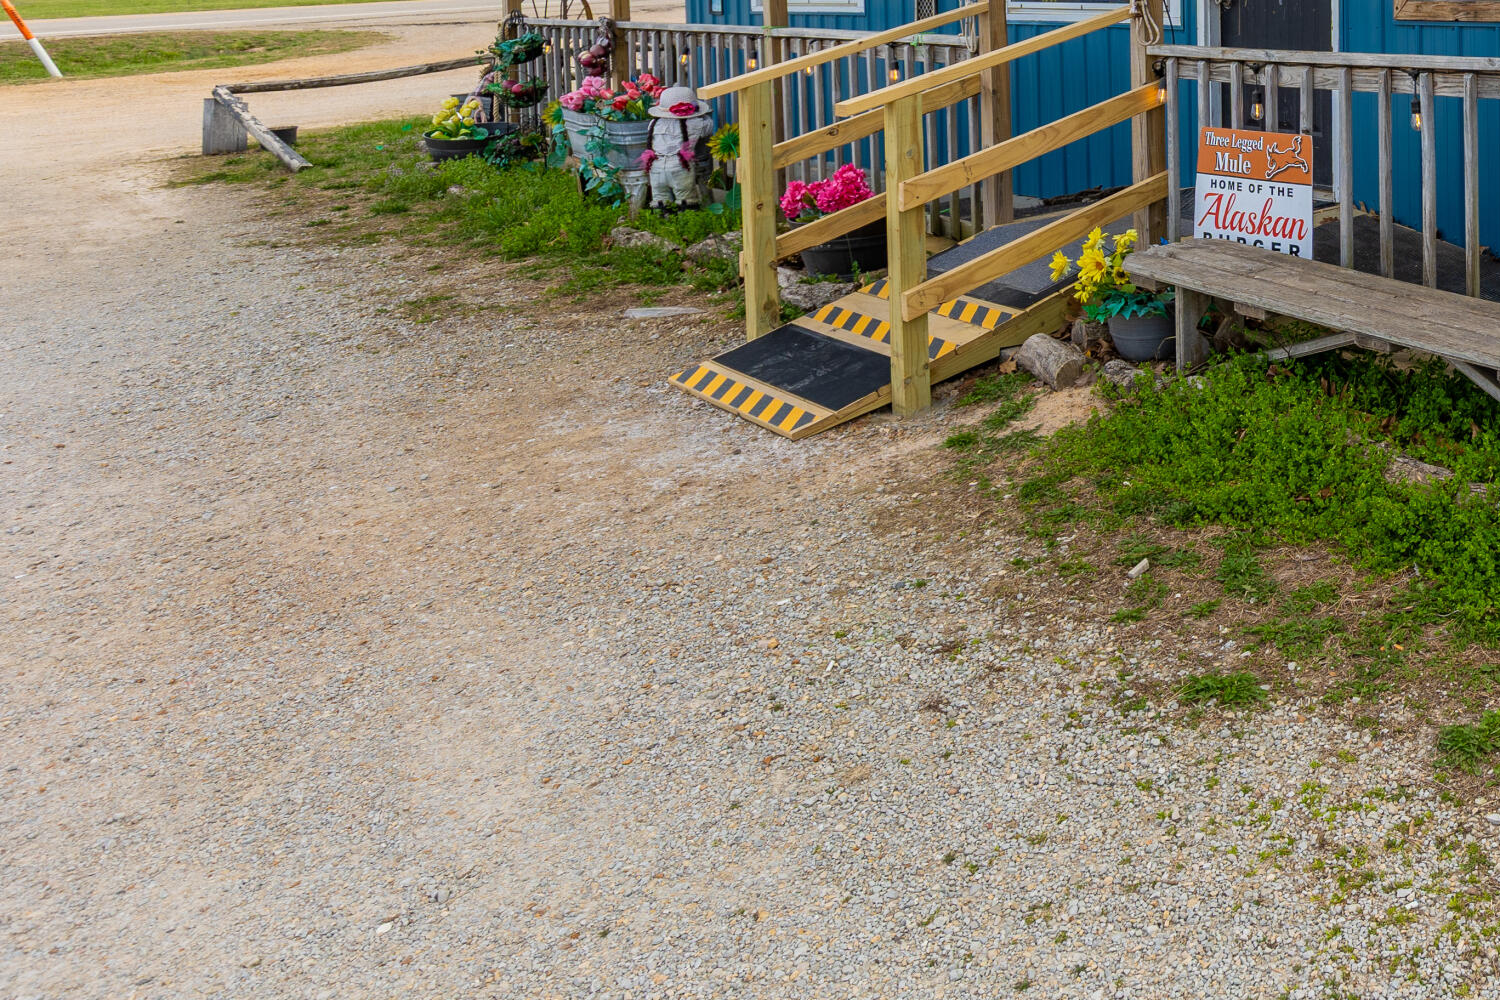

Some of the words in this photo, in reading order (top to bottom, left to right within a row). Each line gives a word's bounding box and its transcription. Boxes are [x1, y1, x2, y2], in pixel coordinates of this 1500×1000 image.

[1205, 131, 1230, 147] Three
[1231, 133, 1264, 153] Legged
[1214, 151, 1252, 175] Mule
[1210, 178, 1243, 192] HOME
[1248, 183, 1263, 194] OF
[1269, 185, 1294, 198] THE
[1197, 192, 1309, 241] Alaskan
